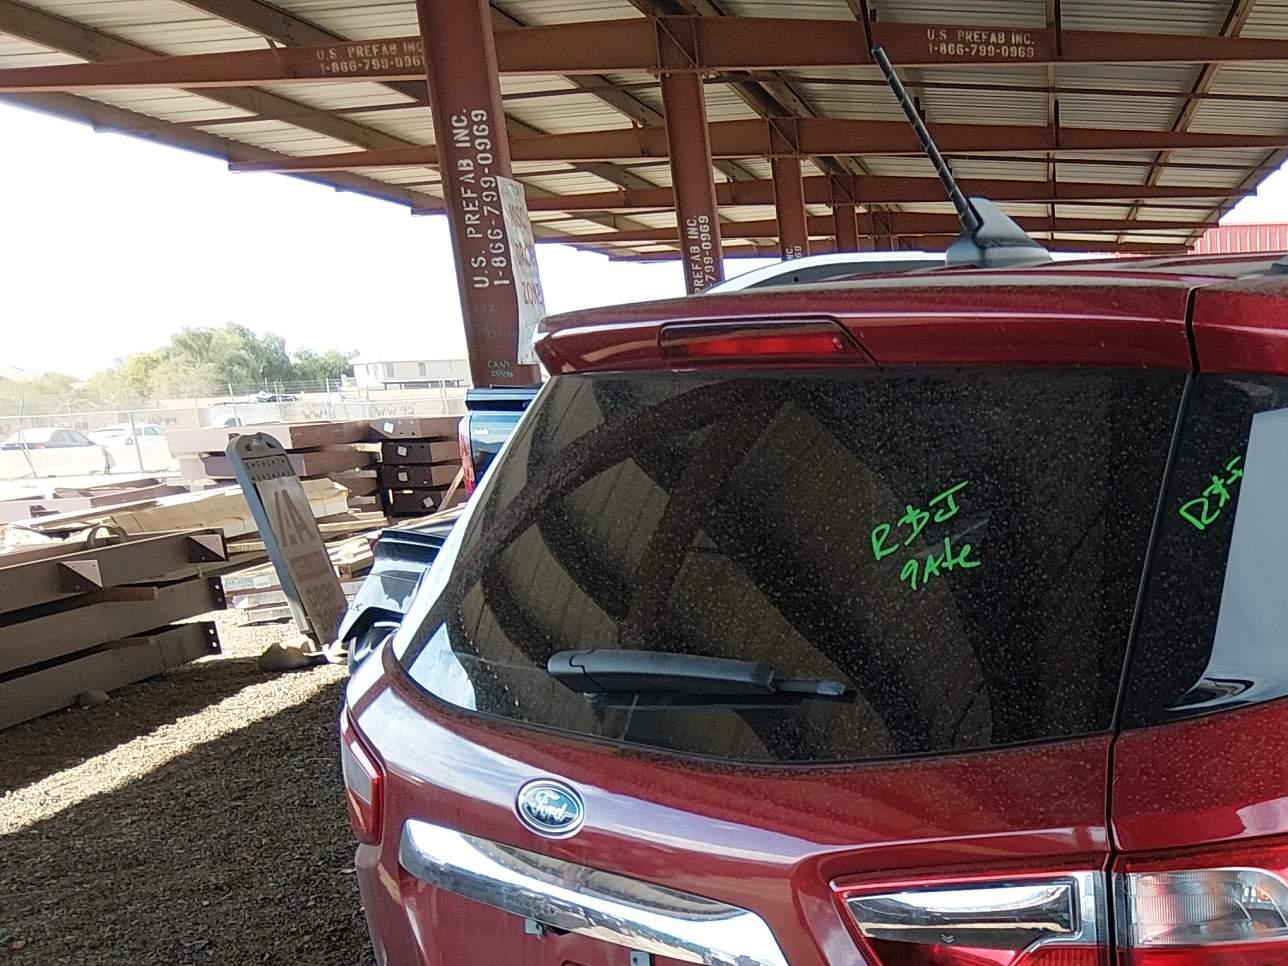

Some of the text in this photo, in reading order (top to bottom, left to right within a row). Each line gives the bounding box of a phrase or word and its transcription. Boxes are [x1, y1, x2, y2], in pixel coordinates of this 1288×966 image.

[347, 42, 398, 59] PREFAB
[929, 43, 1034, 58] 1-866-799-0969
[957, 30, 1006, 44] PREFAB
[1011, 32, 1036, 46] INC.
[451, 108, 472, 148] INC.
[457, 158, 483, 239] PREFAB
[471, 109, 511, 288] 1-866-799-0969
[471, 249, 490, 289] U.S.
[522, 785, 579, 827] Ford
